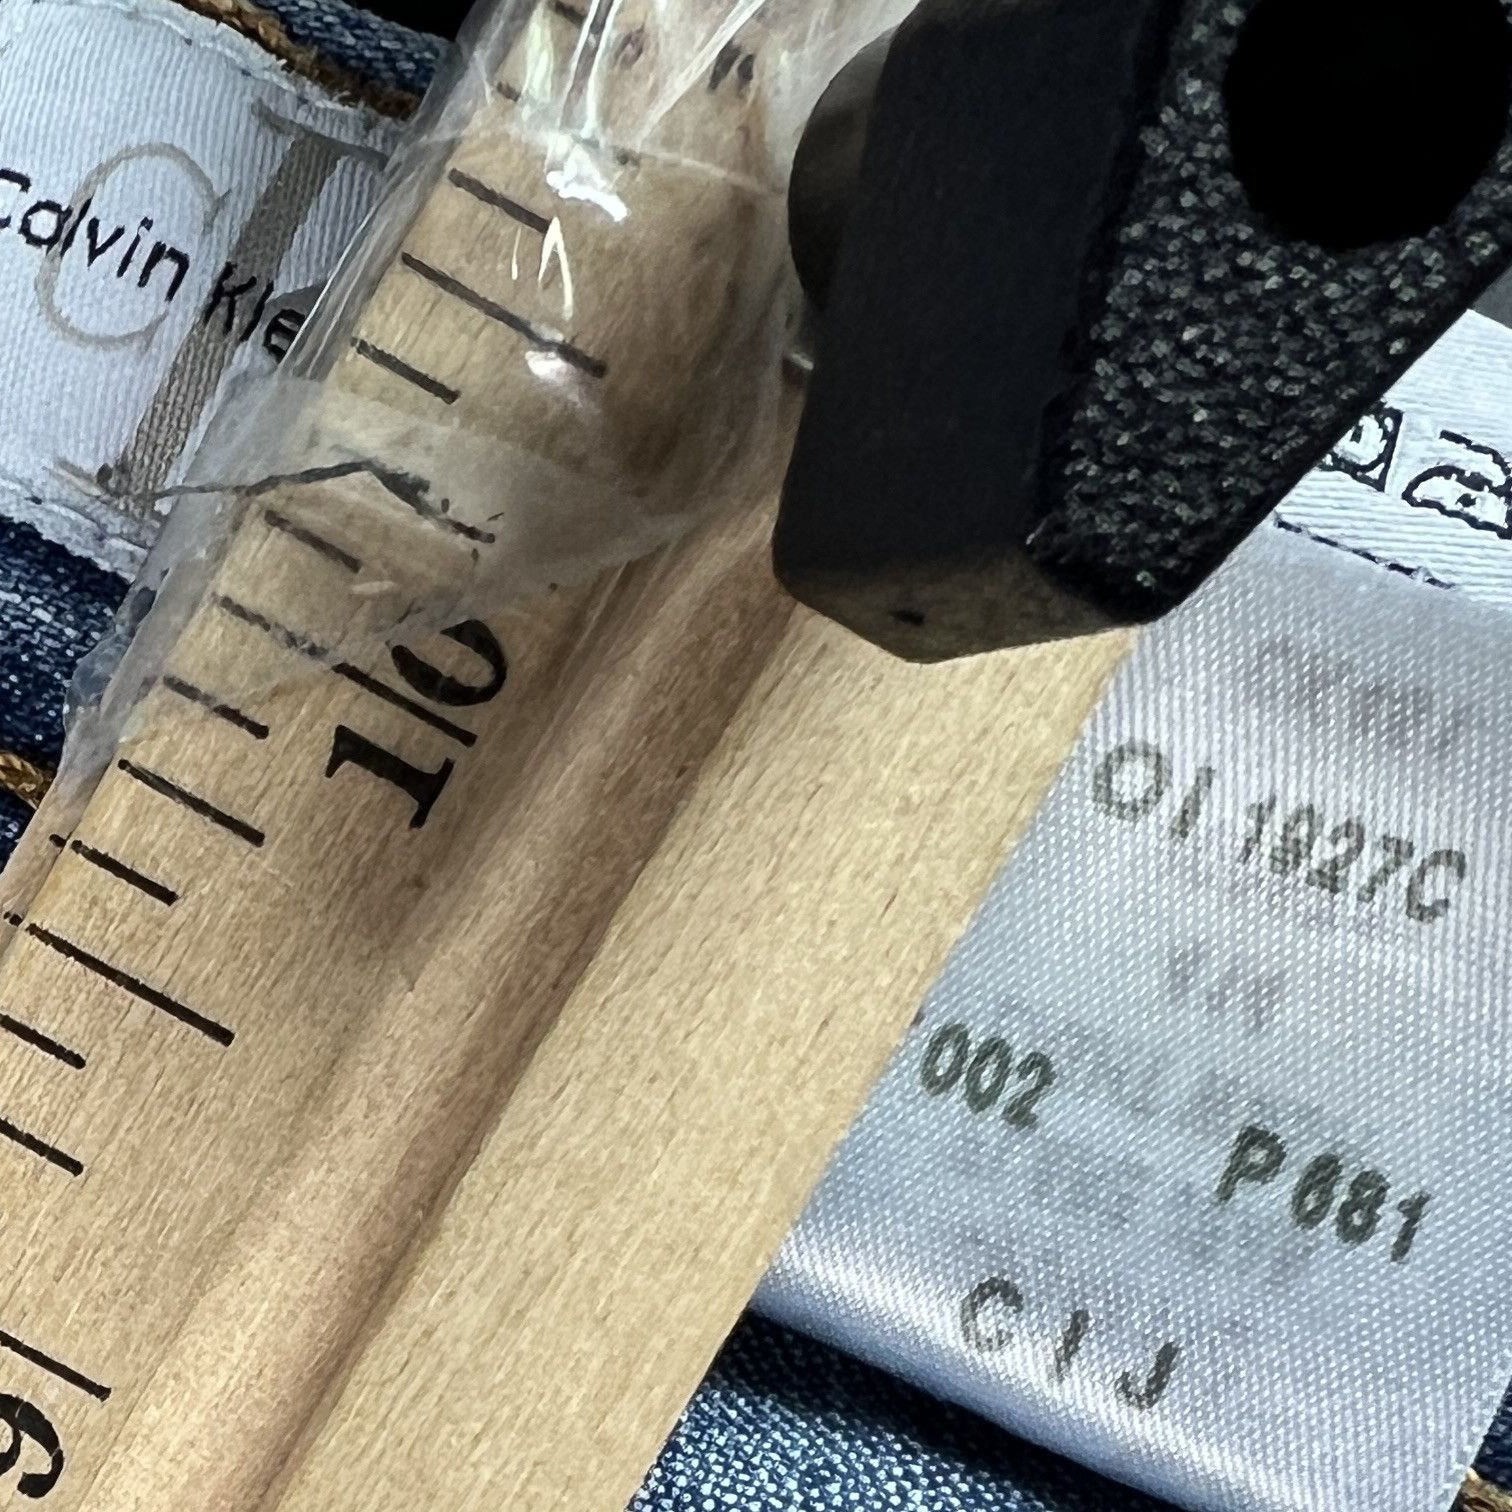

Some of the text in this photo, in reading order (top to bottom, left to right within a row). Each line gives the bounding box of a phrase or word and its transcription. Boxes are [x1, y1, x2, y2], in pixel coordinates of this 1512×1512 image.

[202, 260, 306, 364] Kle
[325, 617, 508, 830] 10
[912, 1008, 1056, 1132] 002
